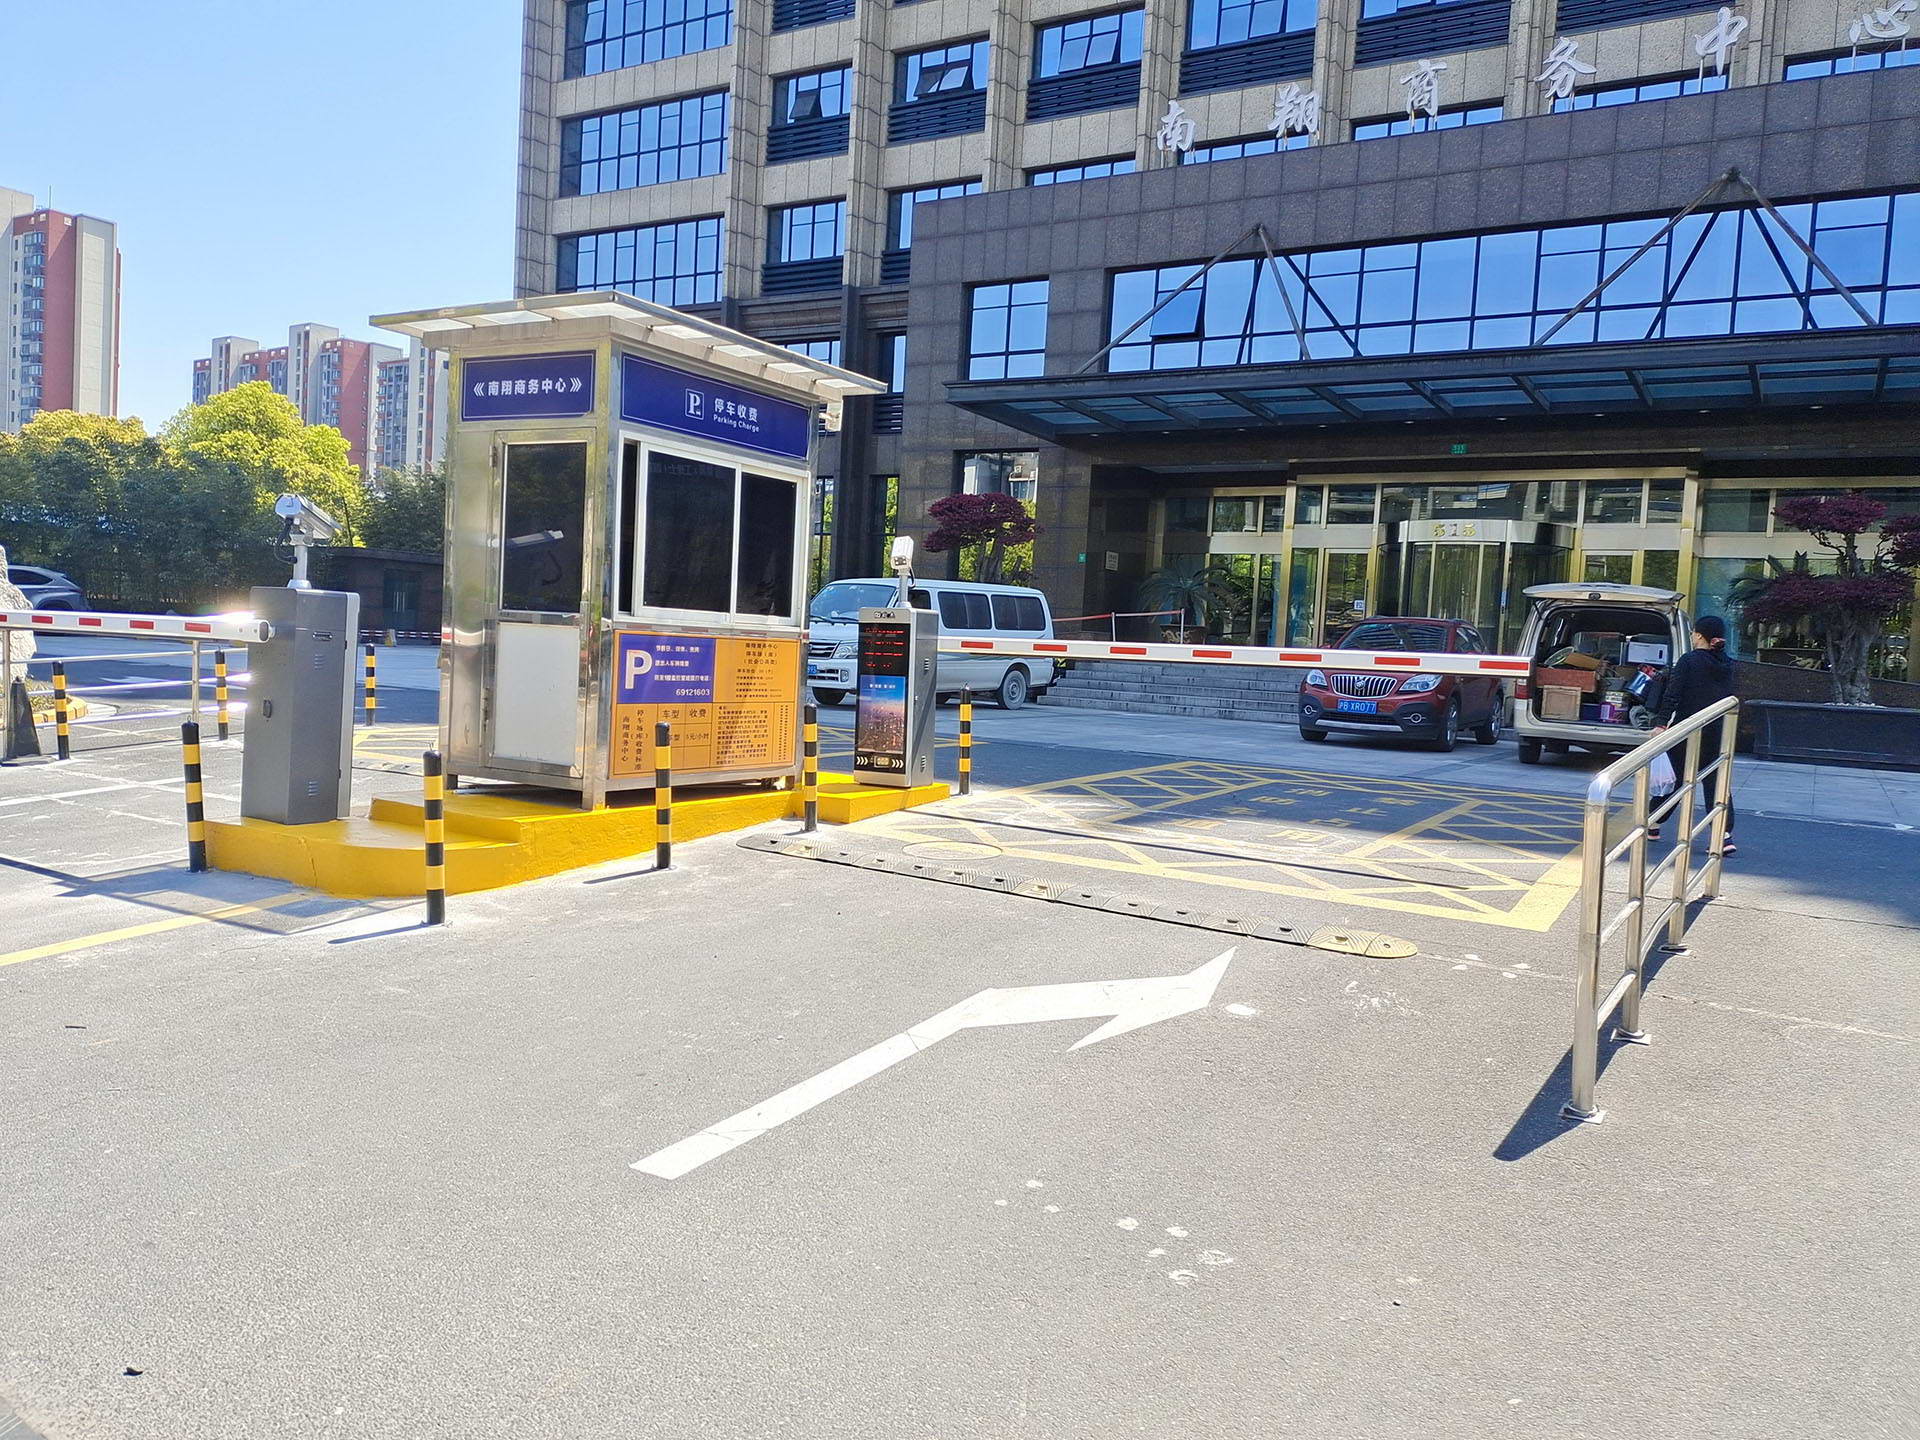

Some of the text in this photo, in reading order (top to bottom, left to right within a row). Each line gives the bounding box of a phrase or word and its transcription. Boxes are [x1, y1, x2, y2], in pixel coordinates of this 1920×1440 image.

[1157, 0, 1918, 152] 南翔商务中心
[488, 378, 566, 396] 南翔商务中心
[714, 398, 758, 422] 停车收费
[713, 413, 759, 432] Parking Charge
[1432, 523, 1476, 537] 515
[625, 649, 652, 689] P
[675, 688, 711, 697] 69121603
[662, 709, 680, 719] 车型
[689, 708, 706, 718] 收费
